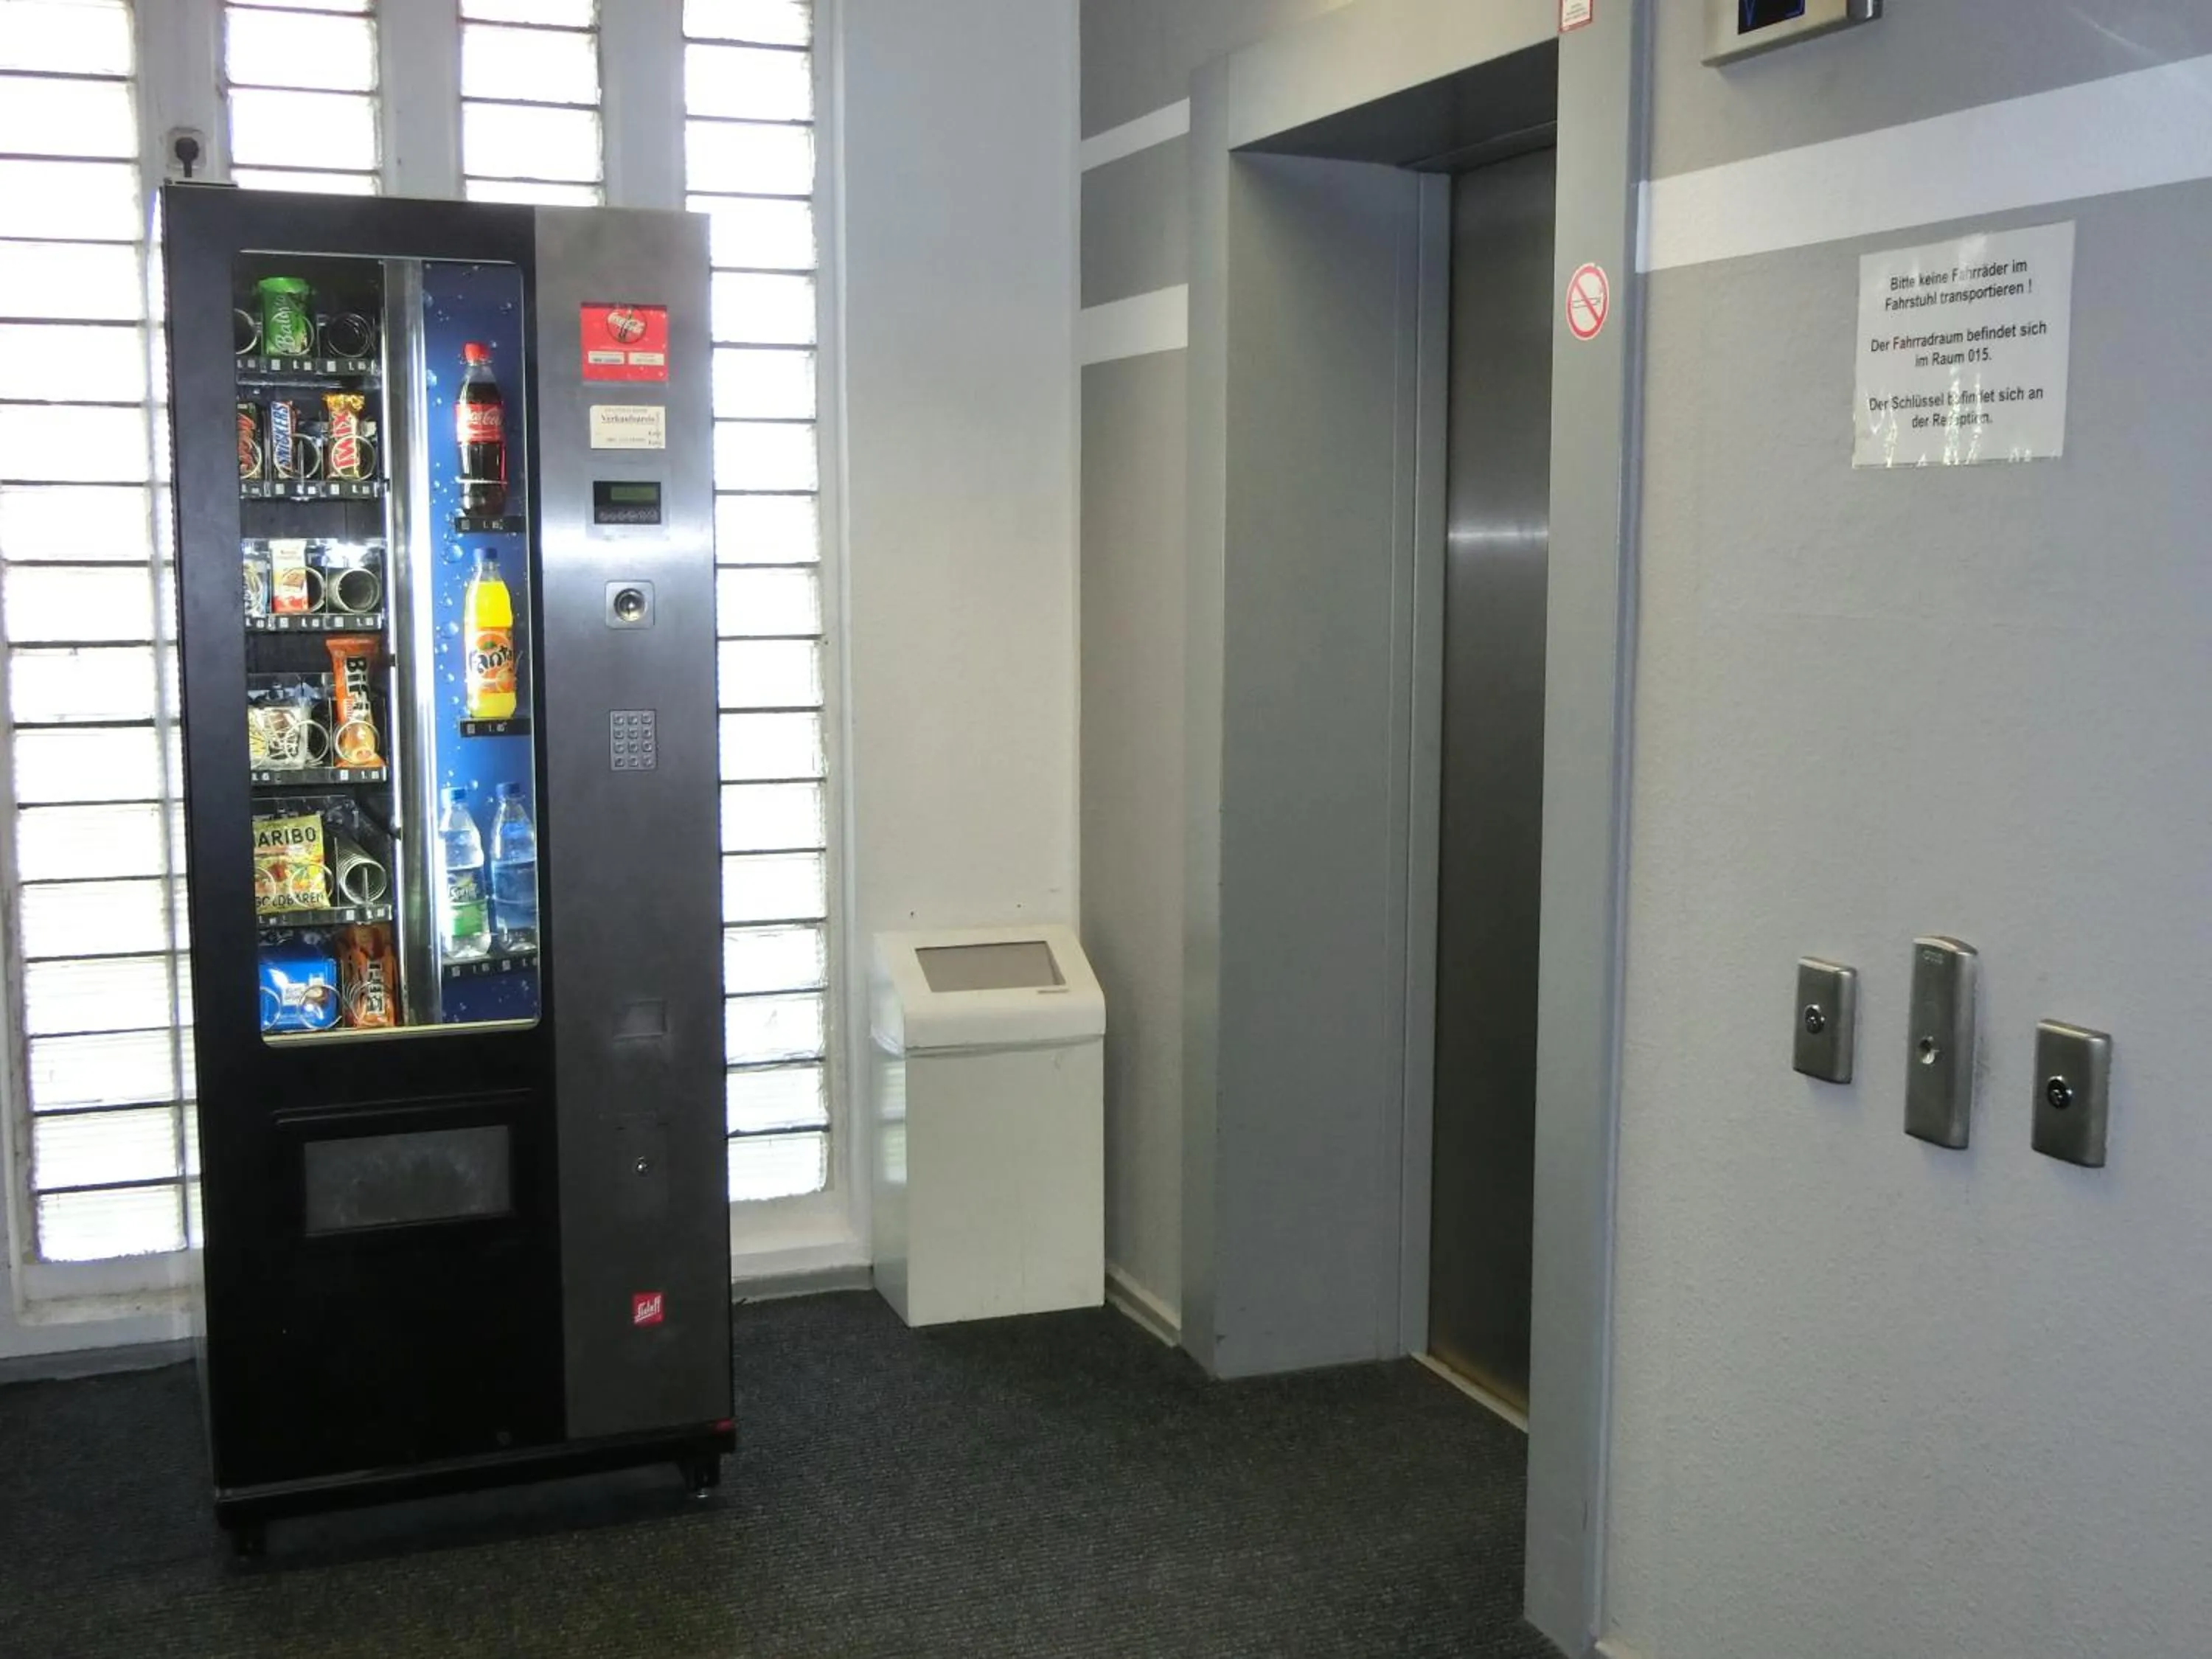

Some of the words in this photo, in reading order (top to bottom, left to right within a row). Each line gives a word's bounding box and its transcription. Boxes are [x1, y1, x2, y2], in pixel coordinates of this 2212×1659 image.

[1891, 276, 1915, 291] Bitte
[1919, 271, 1949, 286] keine
[2012, 259, 2028, 272] im
[1885, 292, 1937, 311] Fahrstuhl
[1940, 282, 2025, 304] transportieren
[1871, 338, 1890, 352] Der
[1893, 331, 1964, 350] Fahrradraum
[1966, 324, 2017, 341] befindet
[2020, 321, 2048, 336] sich
[1915, 355, 1929, 367] im
[1931, 351, 1965, 366] Raum
[1968, 347, 1992, 362] 015.
[1869, 397, 1888, 411] Der
[1891, 392, 1945, 410] Schlüssel
[1999, 386, 2025, 402] sich
[2028, 387, 2044, 400] an
[1912, 414, 1929, 428] der
[1933, 411, 1992, 428] Reeption.
[273, 404, 292, 468] SNICKERS
[254, 827, 316, 847] ARIBO
